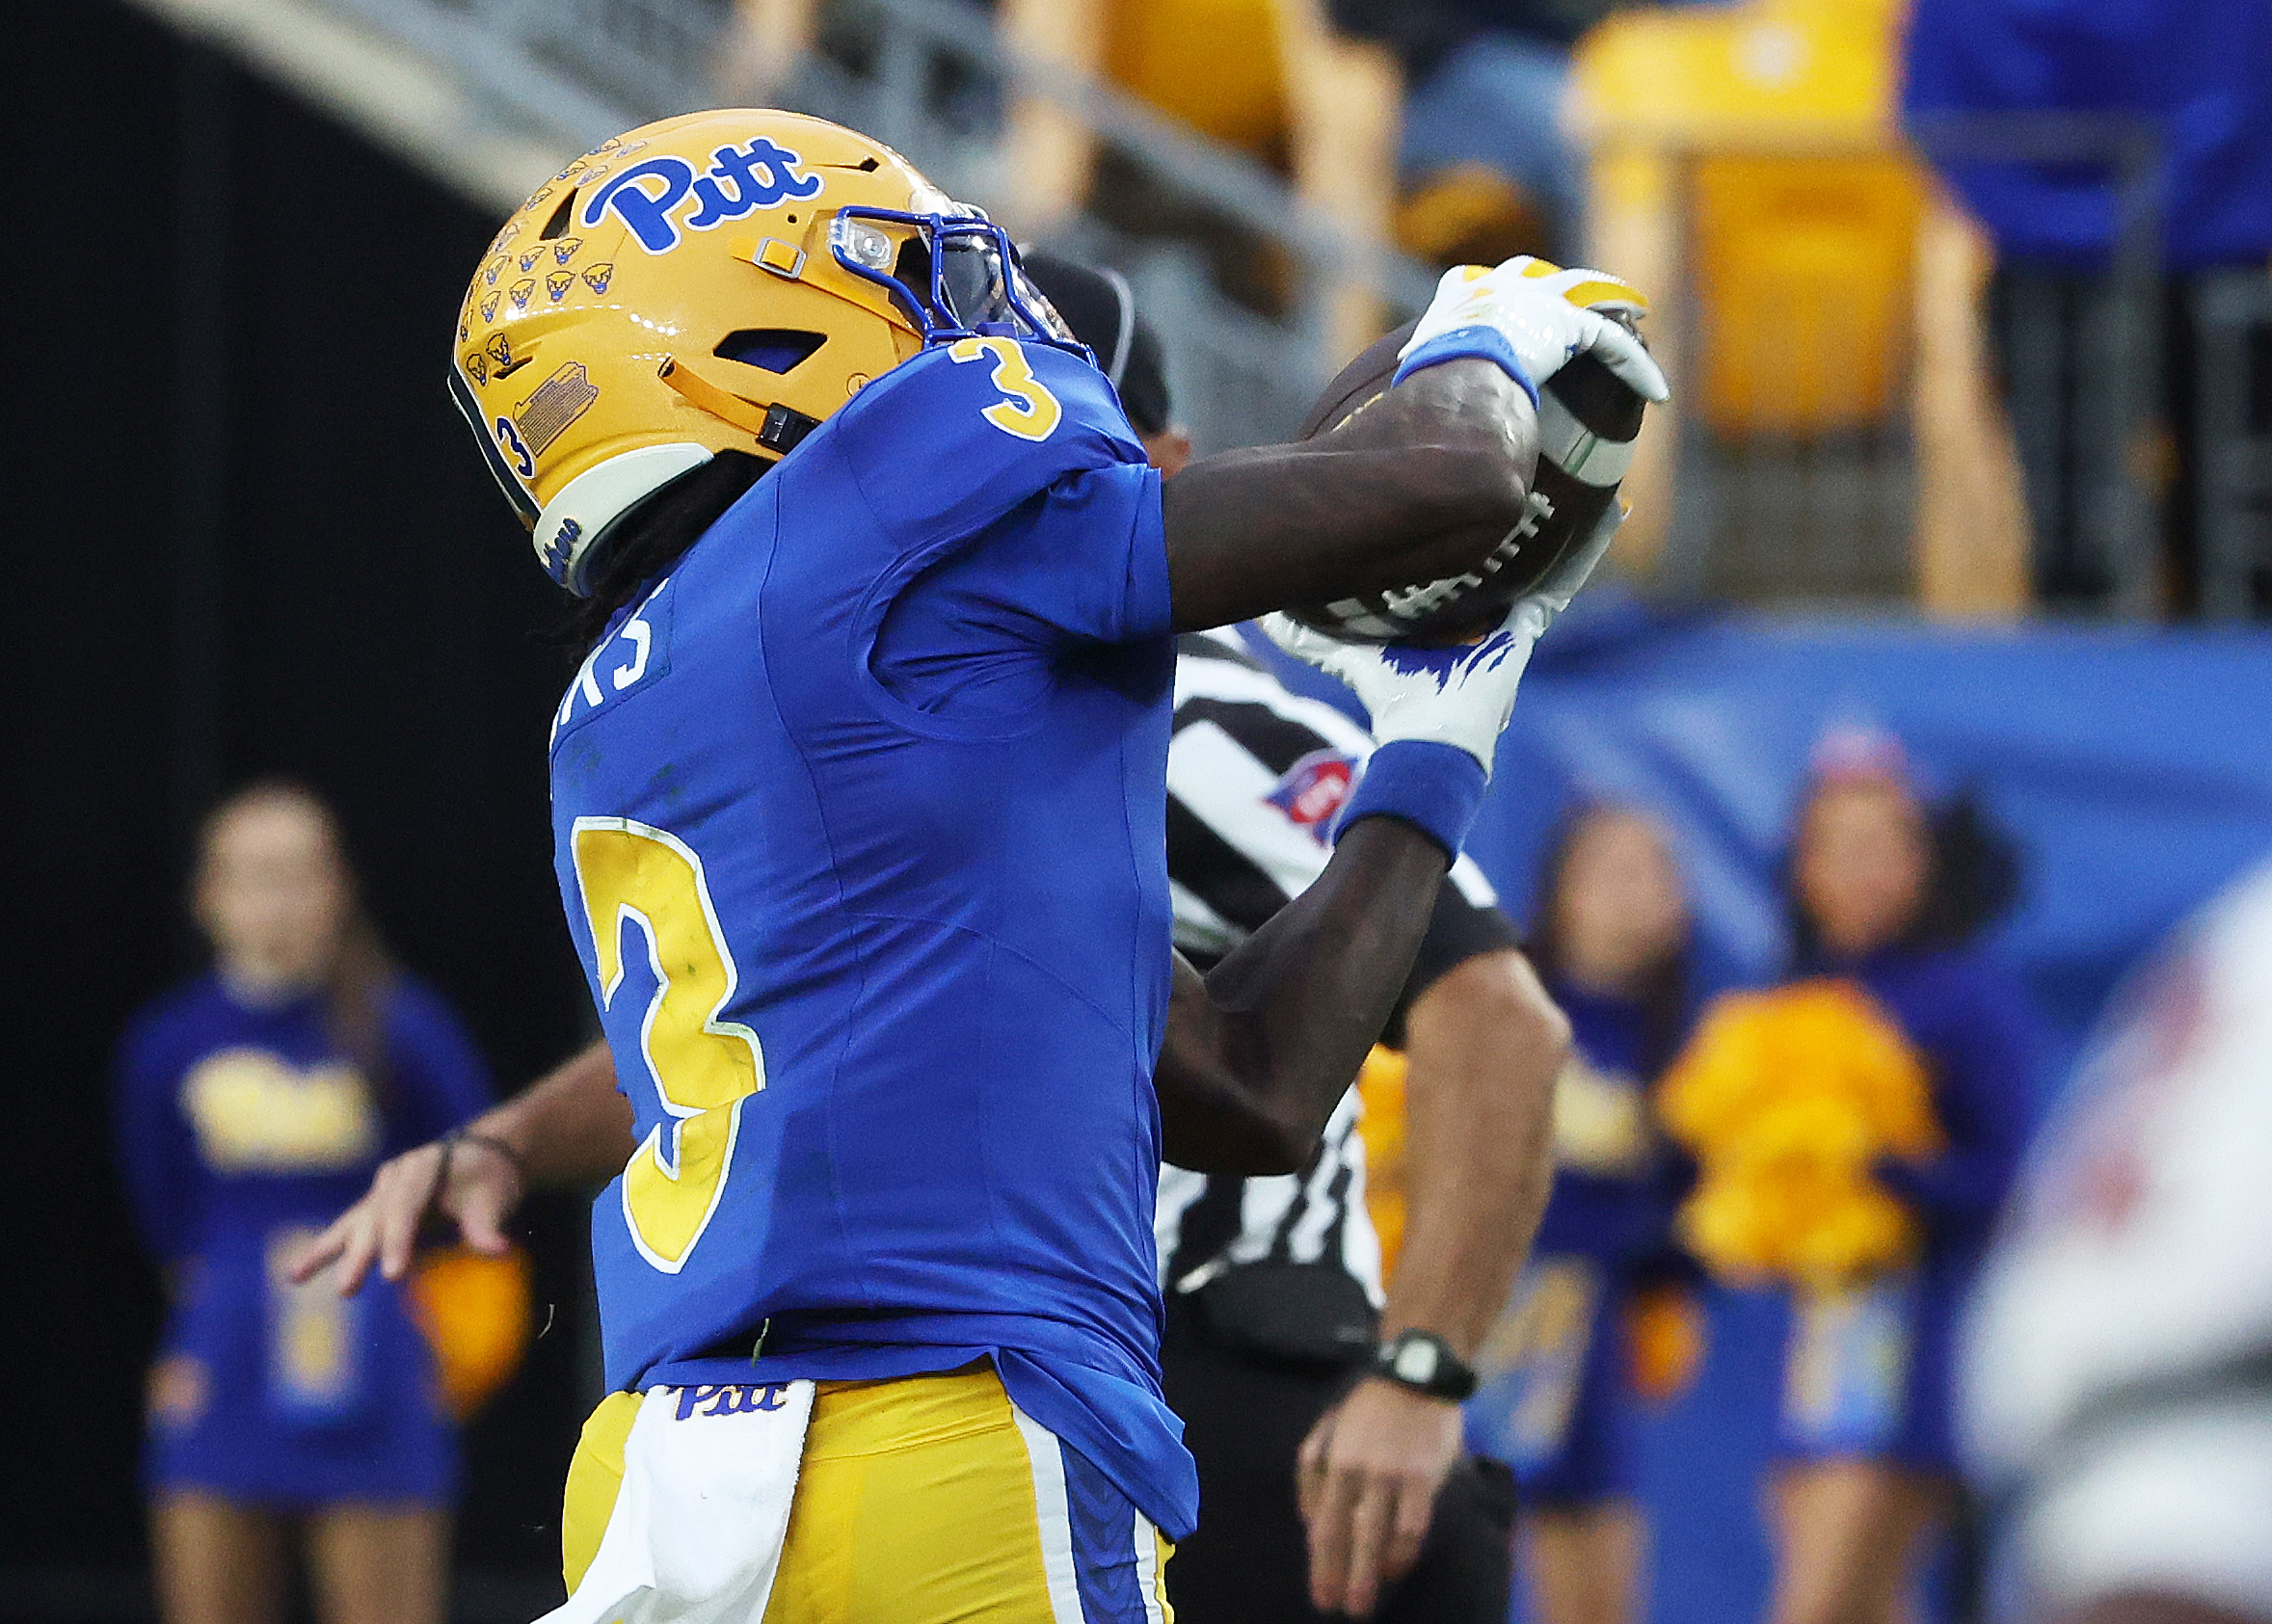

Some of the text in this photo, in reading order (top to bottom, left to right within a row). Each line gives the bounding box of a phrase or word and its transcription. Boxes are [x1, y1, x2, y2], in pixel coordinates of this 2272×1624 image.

[581, 137, 823, 255] Pitt
[948, 335, 1062, 442] 3
[496, 416, 535, 479] 3
[572, 816, 766, 1273] 3
